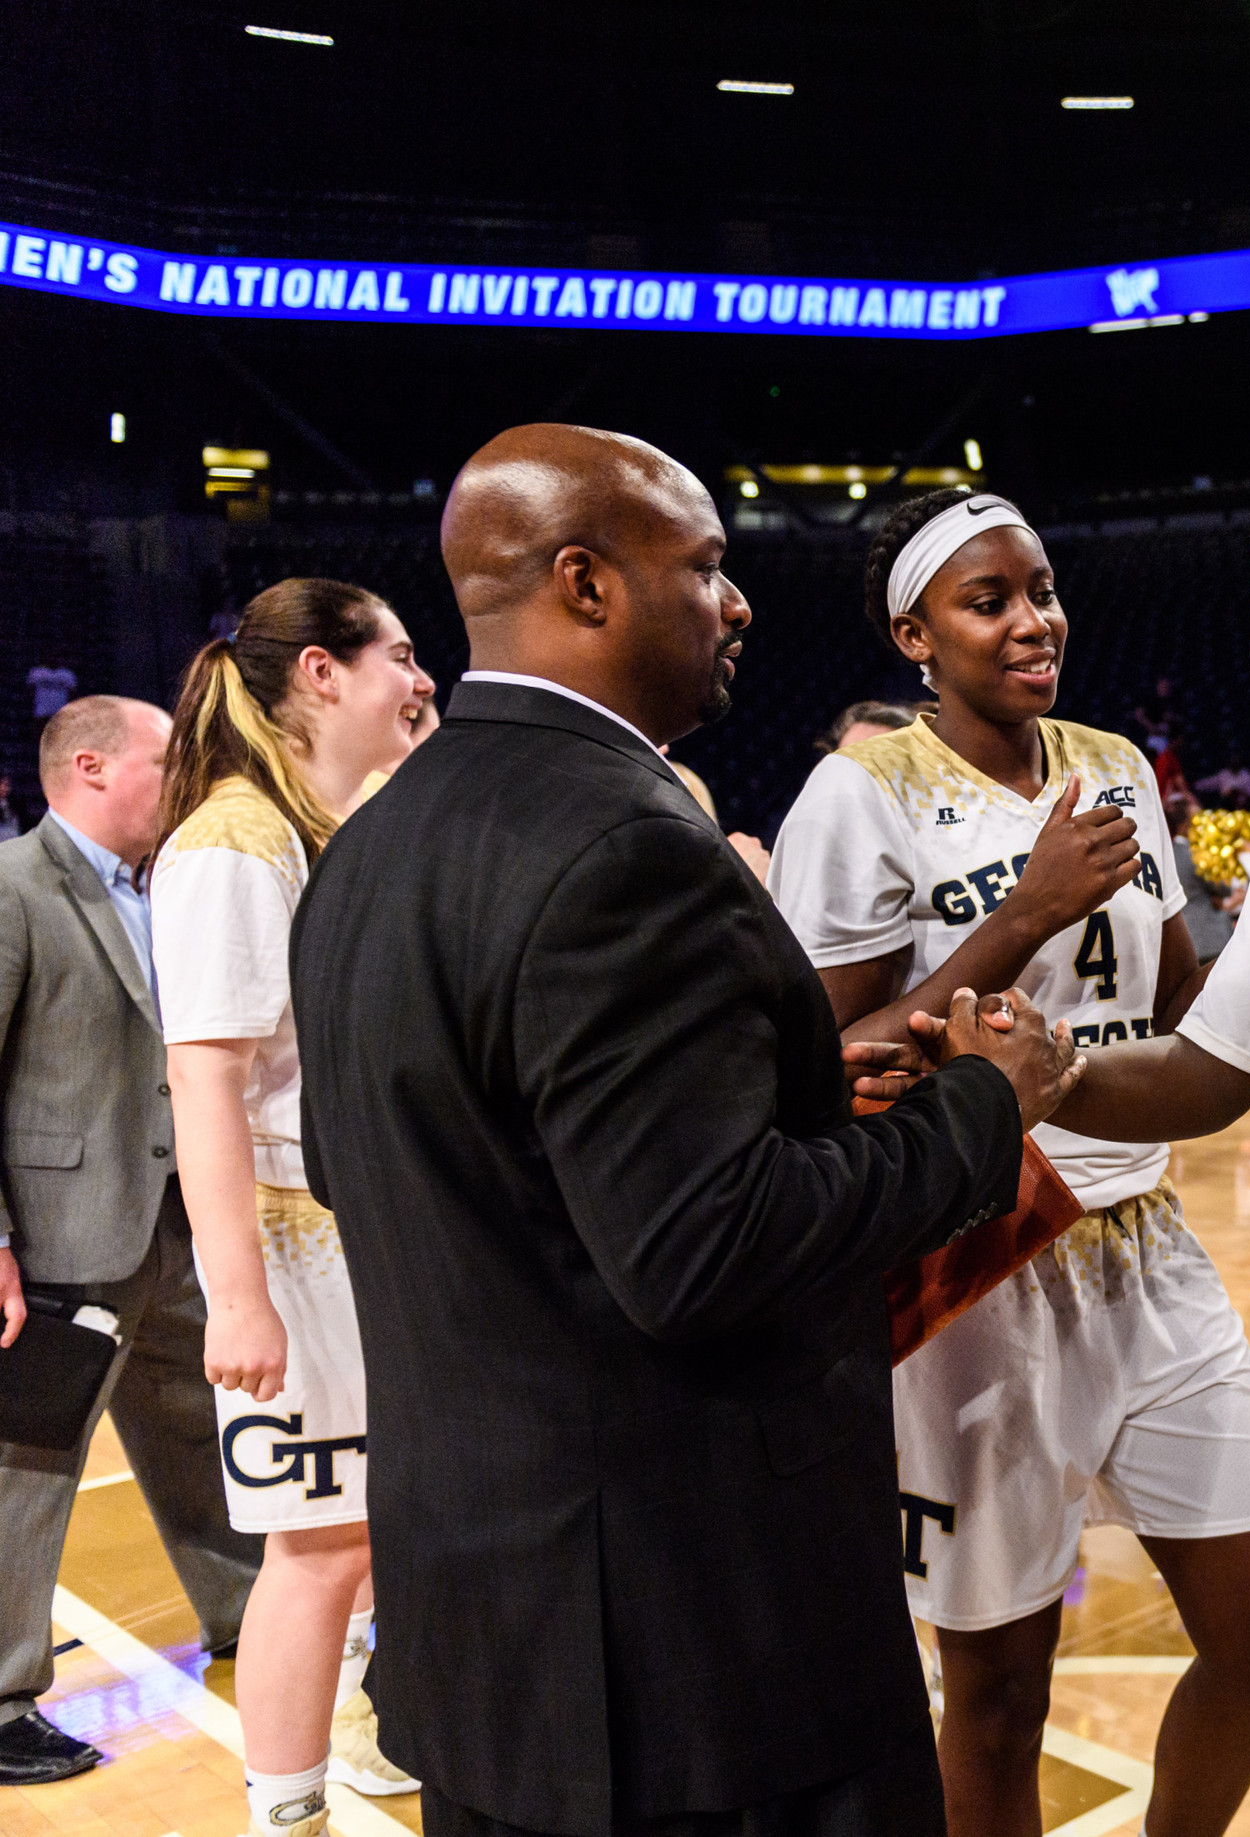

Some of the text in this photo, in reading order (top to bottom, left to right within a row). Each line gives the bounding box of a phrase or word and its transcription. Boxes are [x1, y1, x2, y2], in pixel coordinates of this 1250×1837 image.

[0, 231, 1006, 329] EN'S NATIONAL INVITATION TOURNAMENT
[1072, 907, 1119, 1004] 4
[221, 1411, 367, 1501] GT
